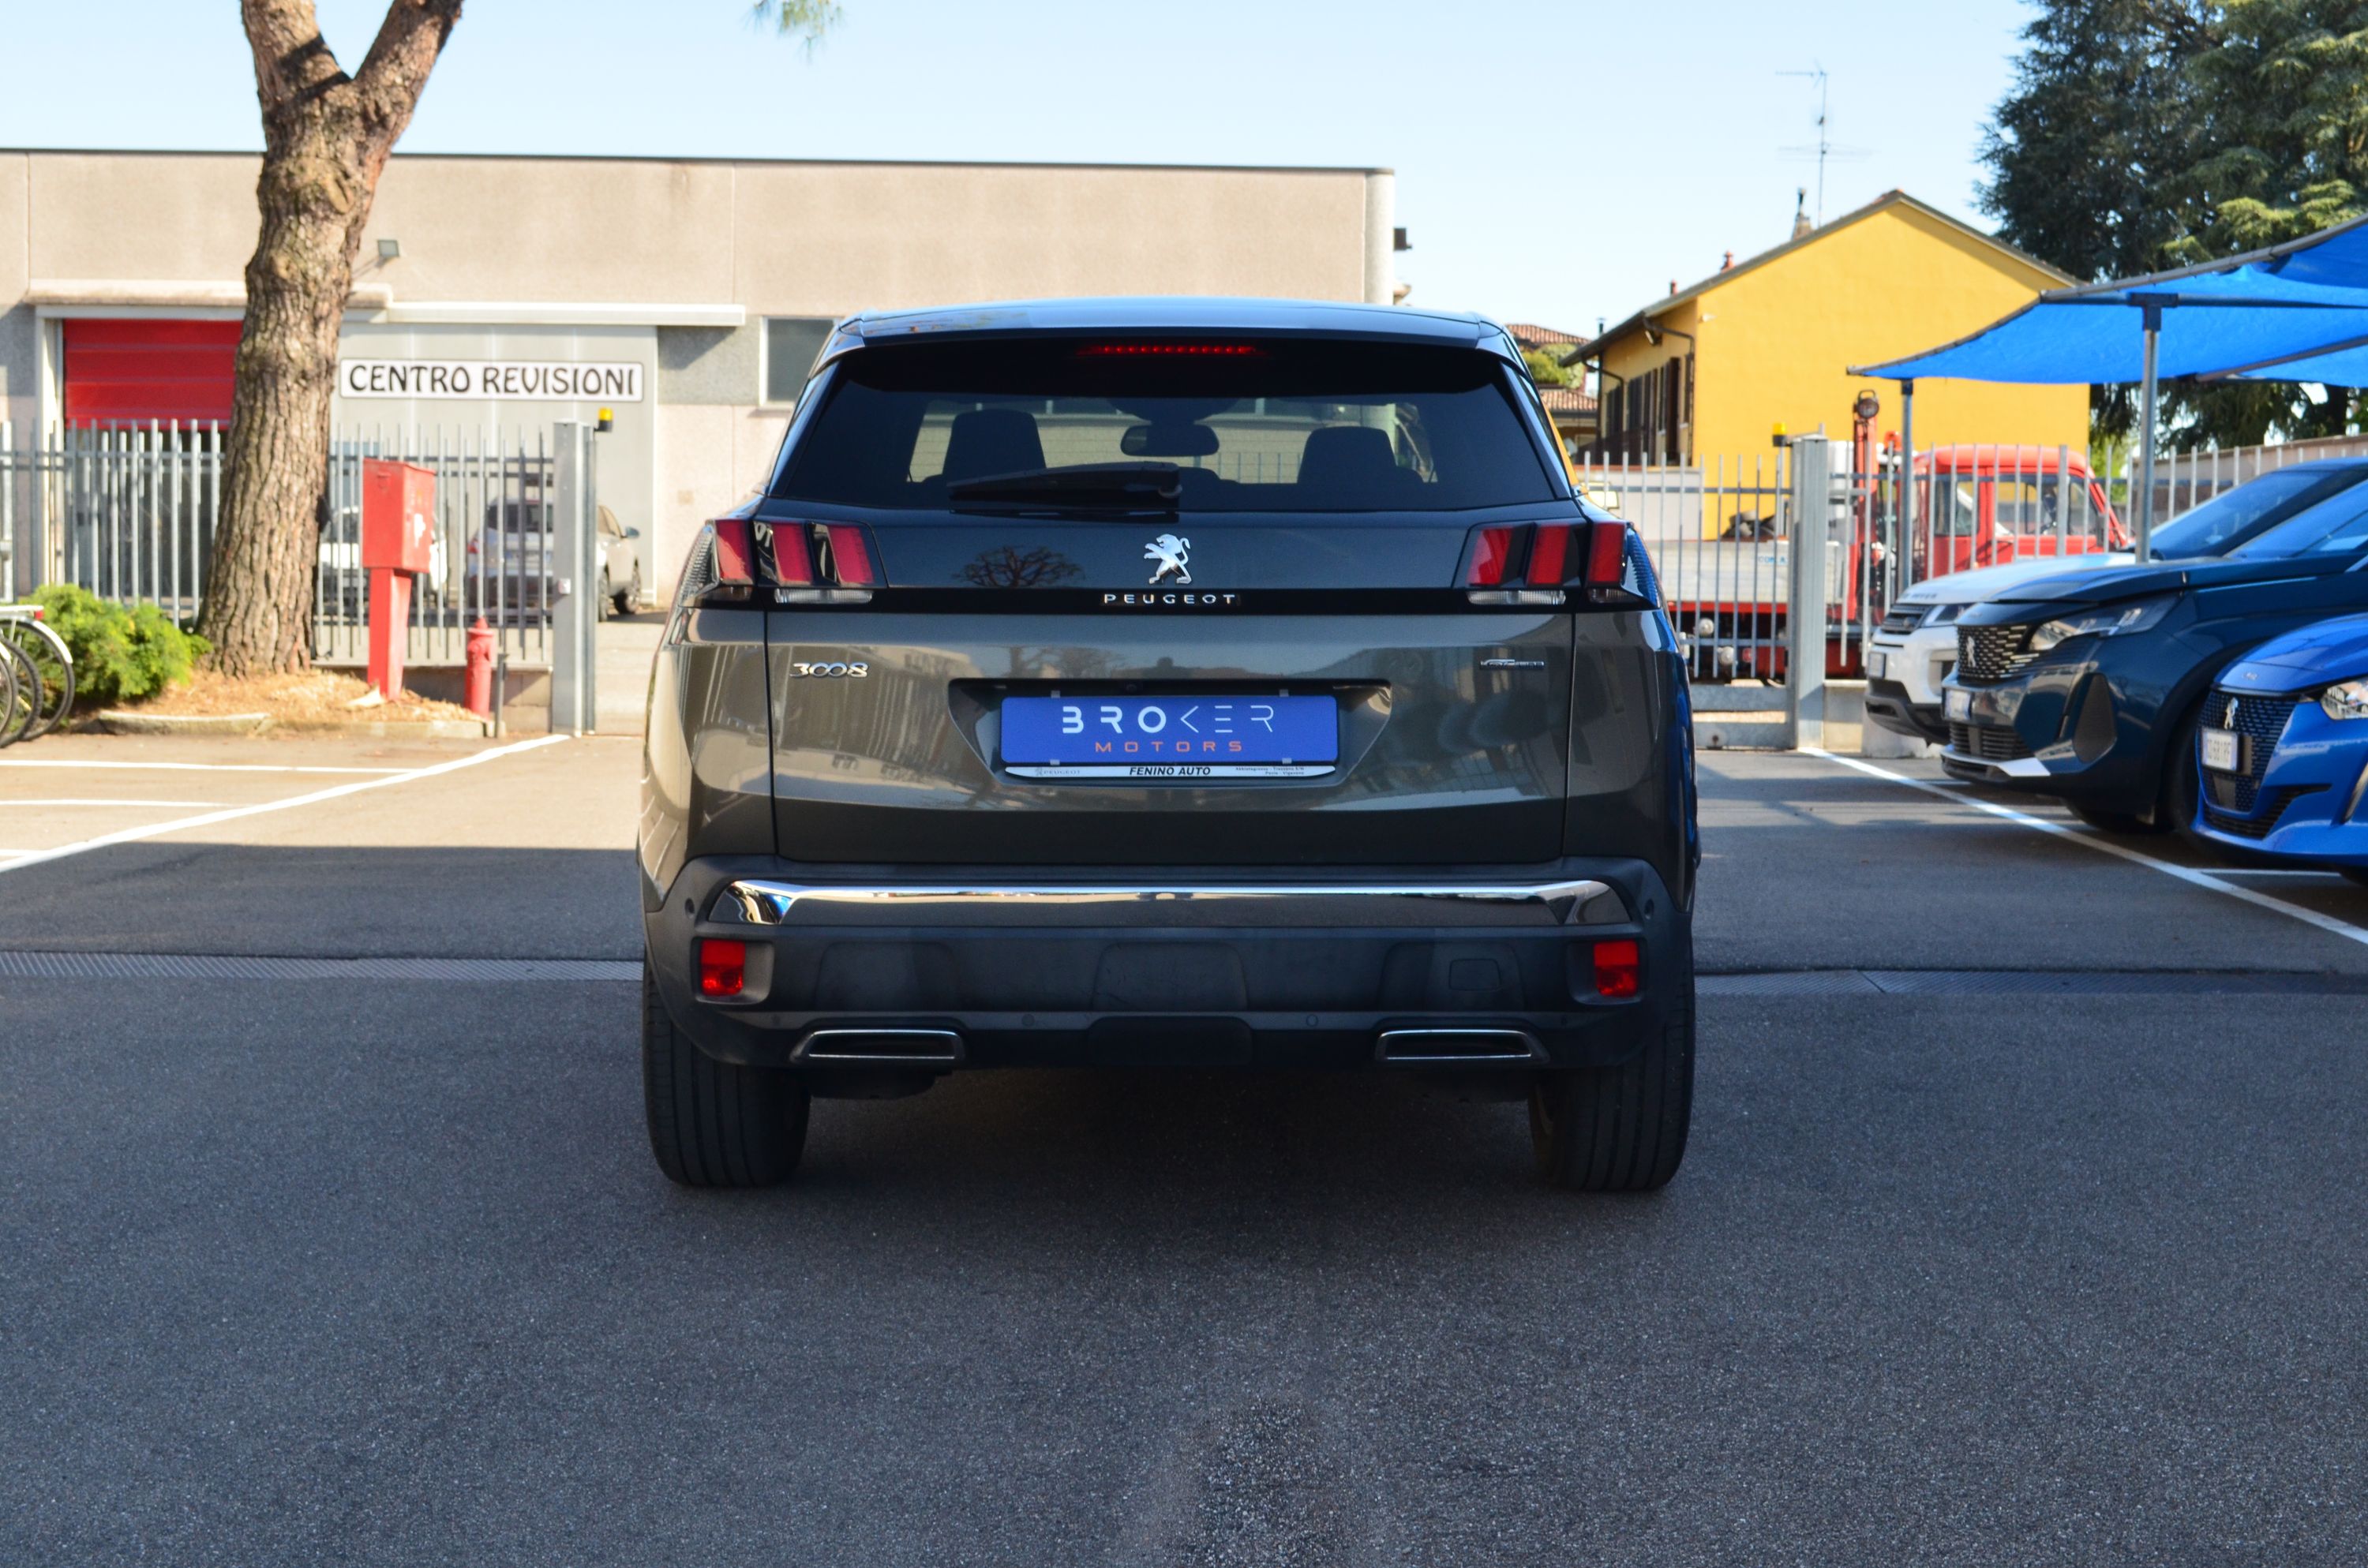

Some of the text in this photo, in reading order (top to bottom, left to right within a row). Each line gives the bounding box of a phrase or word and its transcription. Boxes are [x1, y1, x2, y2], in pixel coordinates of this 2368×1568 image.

[349, 365, 633, 395] CENTRO REVISIONI
[1104, 593, 1235, 604] PEUGEOT
[789, 662, 868, 678] 3008
[1062, 705, 1274, 734] BROKER
[1095, 740, 1242, 753] MOTORS
[1130, 766, 1211, 776] FENINO AUTO
